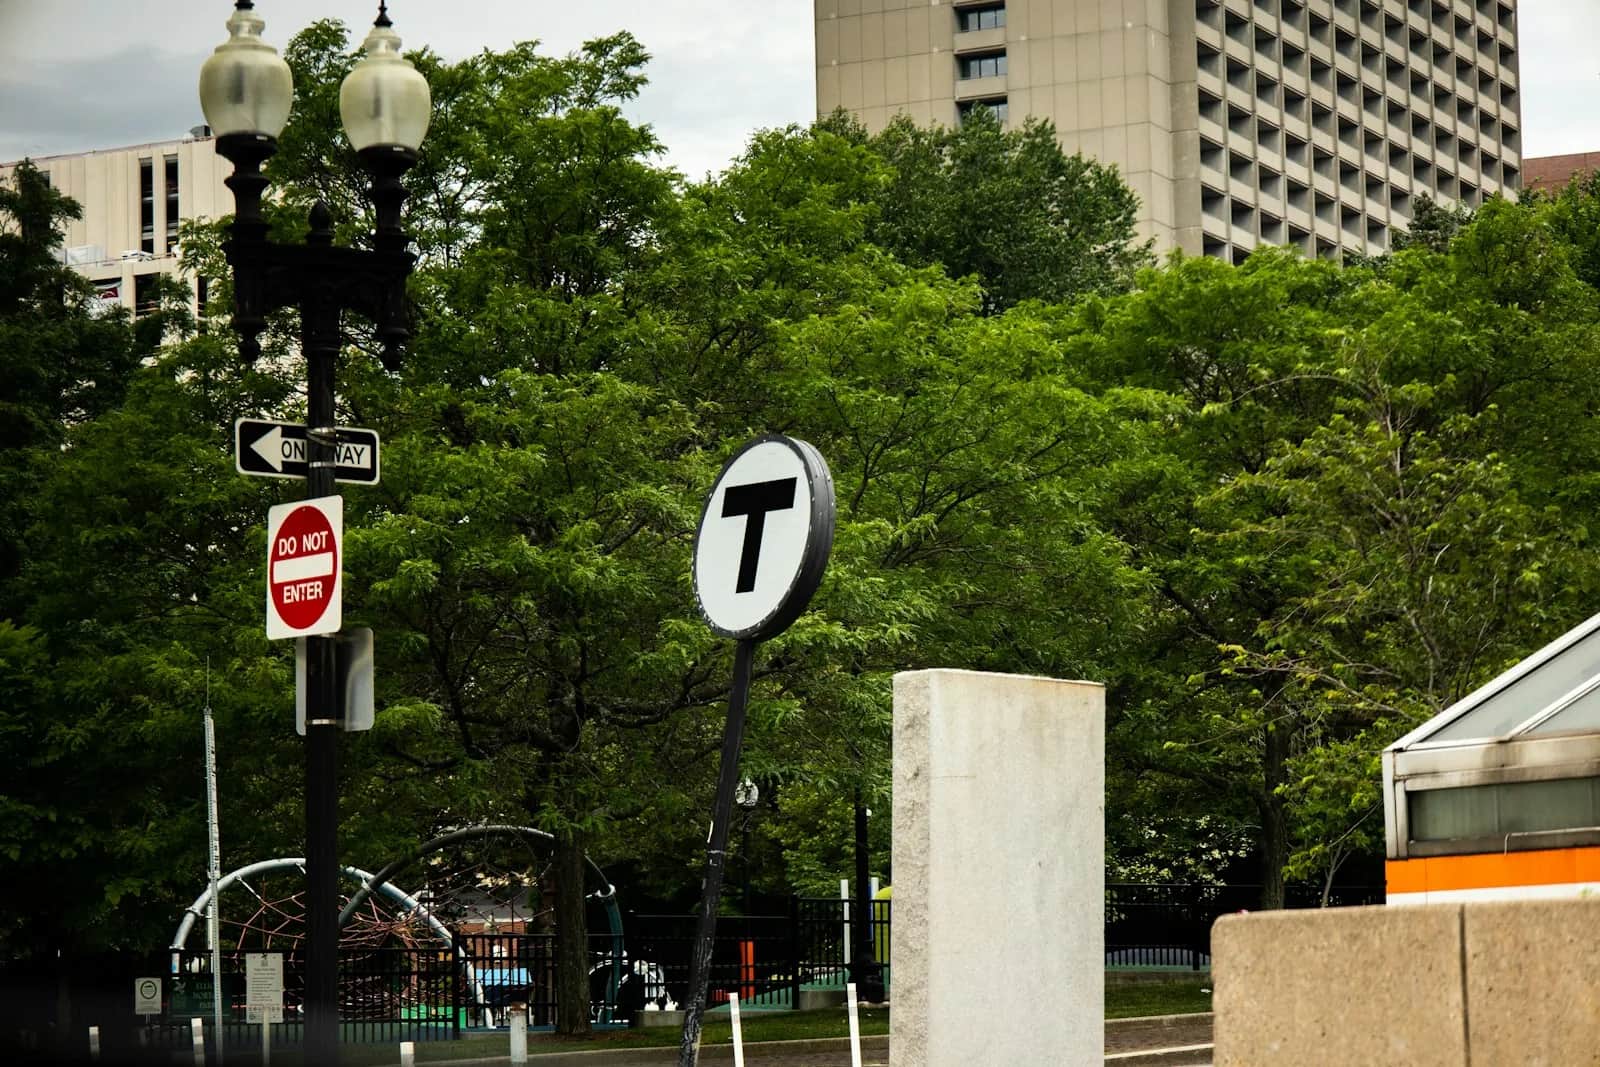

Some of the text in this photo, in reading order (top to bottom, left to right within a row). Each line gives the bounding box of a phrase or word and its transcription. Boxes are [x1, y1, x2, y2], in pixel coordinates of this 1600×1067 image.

[281, 440, 305, 461] ON
[278, 531, 328, 557] DO NOT
[721, 477, 798, 594] T
[283, 581, 323, 604] ENTER
